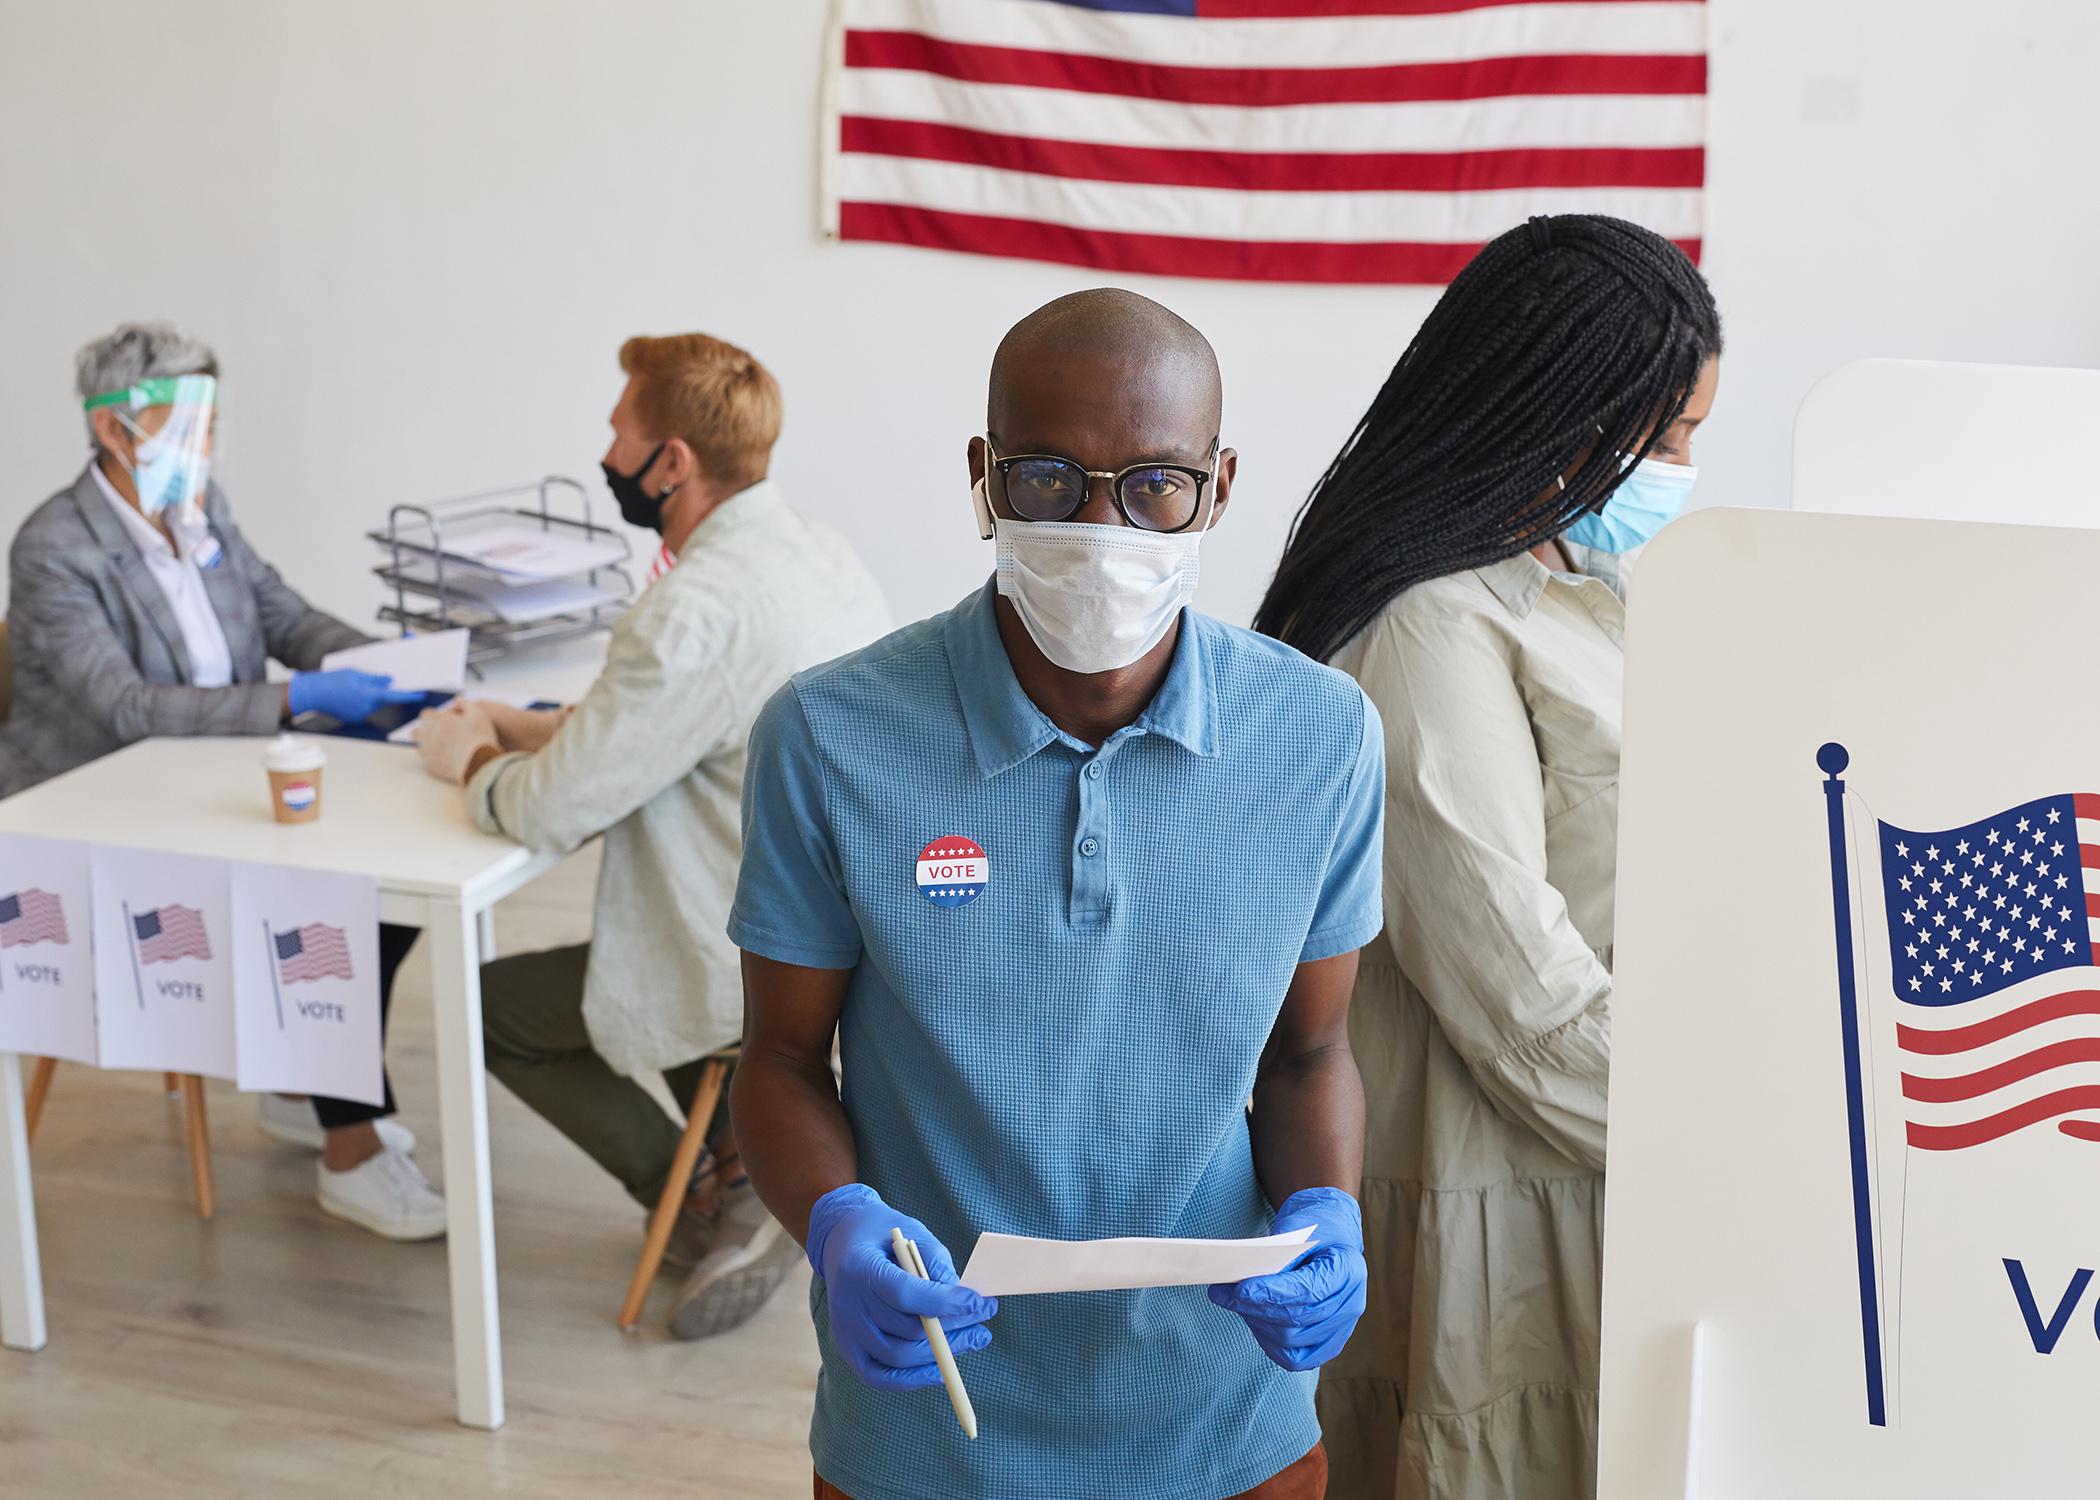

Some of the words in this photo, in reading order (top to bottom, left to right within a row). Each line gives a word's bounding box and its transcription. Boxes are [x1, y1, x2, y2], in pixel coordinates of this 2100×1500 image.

[928, 865, 975, 879] VOTE
[15, 963, 62, 986] VOTE
[157, 980, 205, 1001] VOTE
[298, 1000, 346, 1022] VOTE
[2001, 1257, 2100, 1355] V
